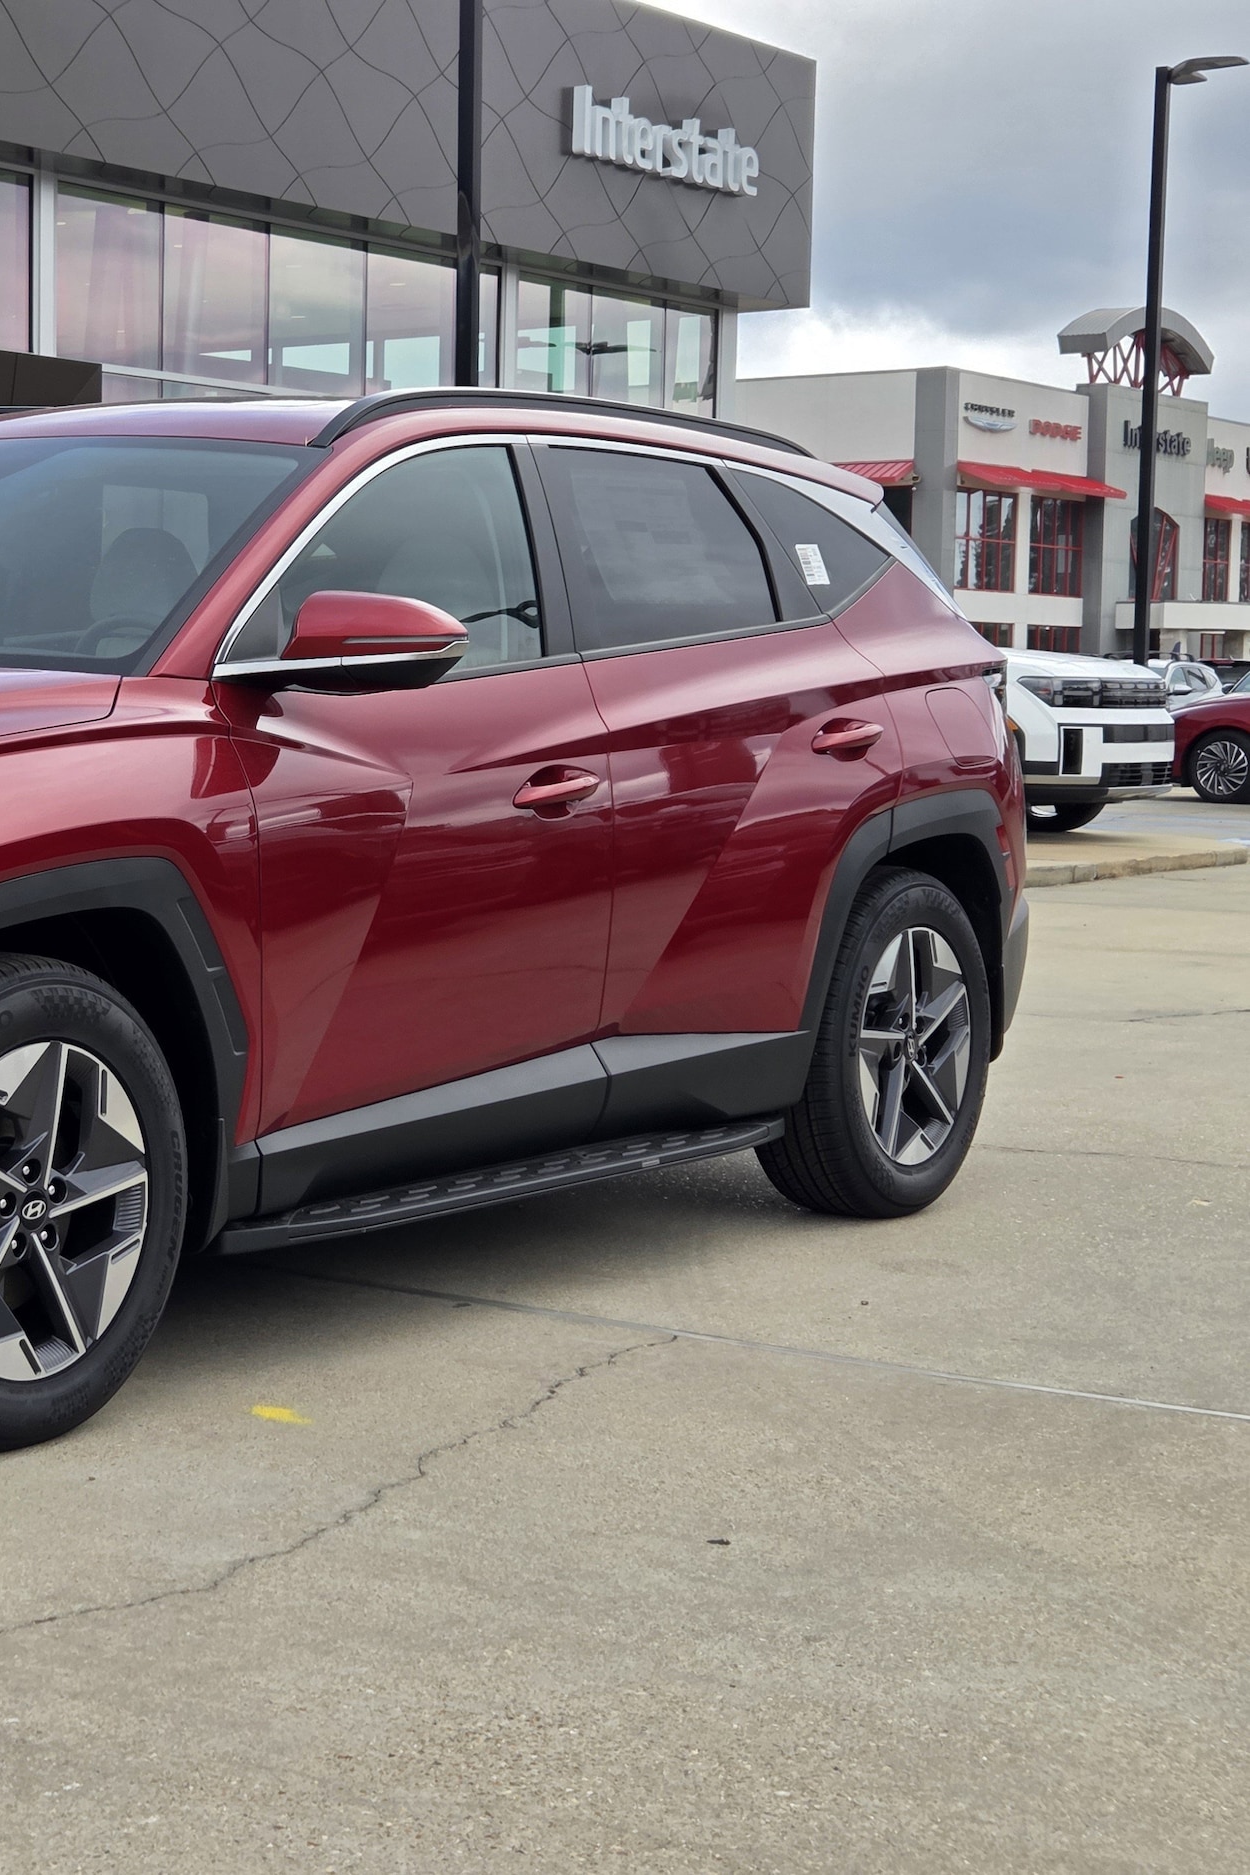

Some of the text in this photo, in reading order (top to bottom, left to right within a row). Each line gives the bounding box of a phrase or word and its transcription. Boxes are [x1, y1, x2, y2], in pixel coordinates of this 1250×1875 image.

[571, 84, 759, 197] Interstate
[1029, 418, 1082, 442] DODGE
[1123, 420, 1191, 457] Instate
[167, 1129, 183, 1262] CRUGEN
